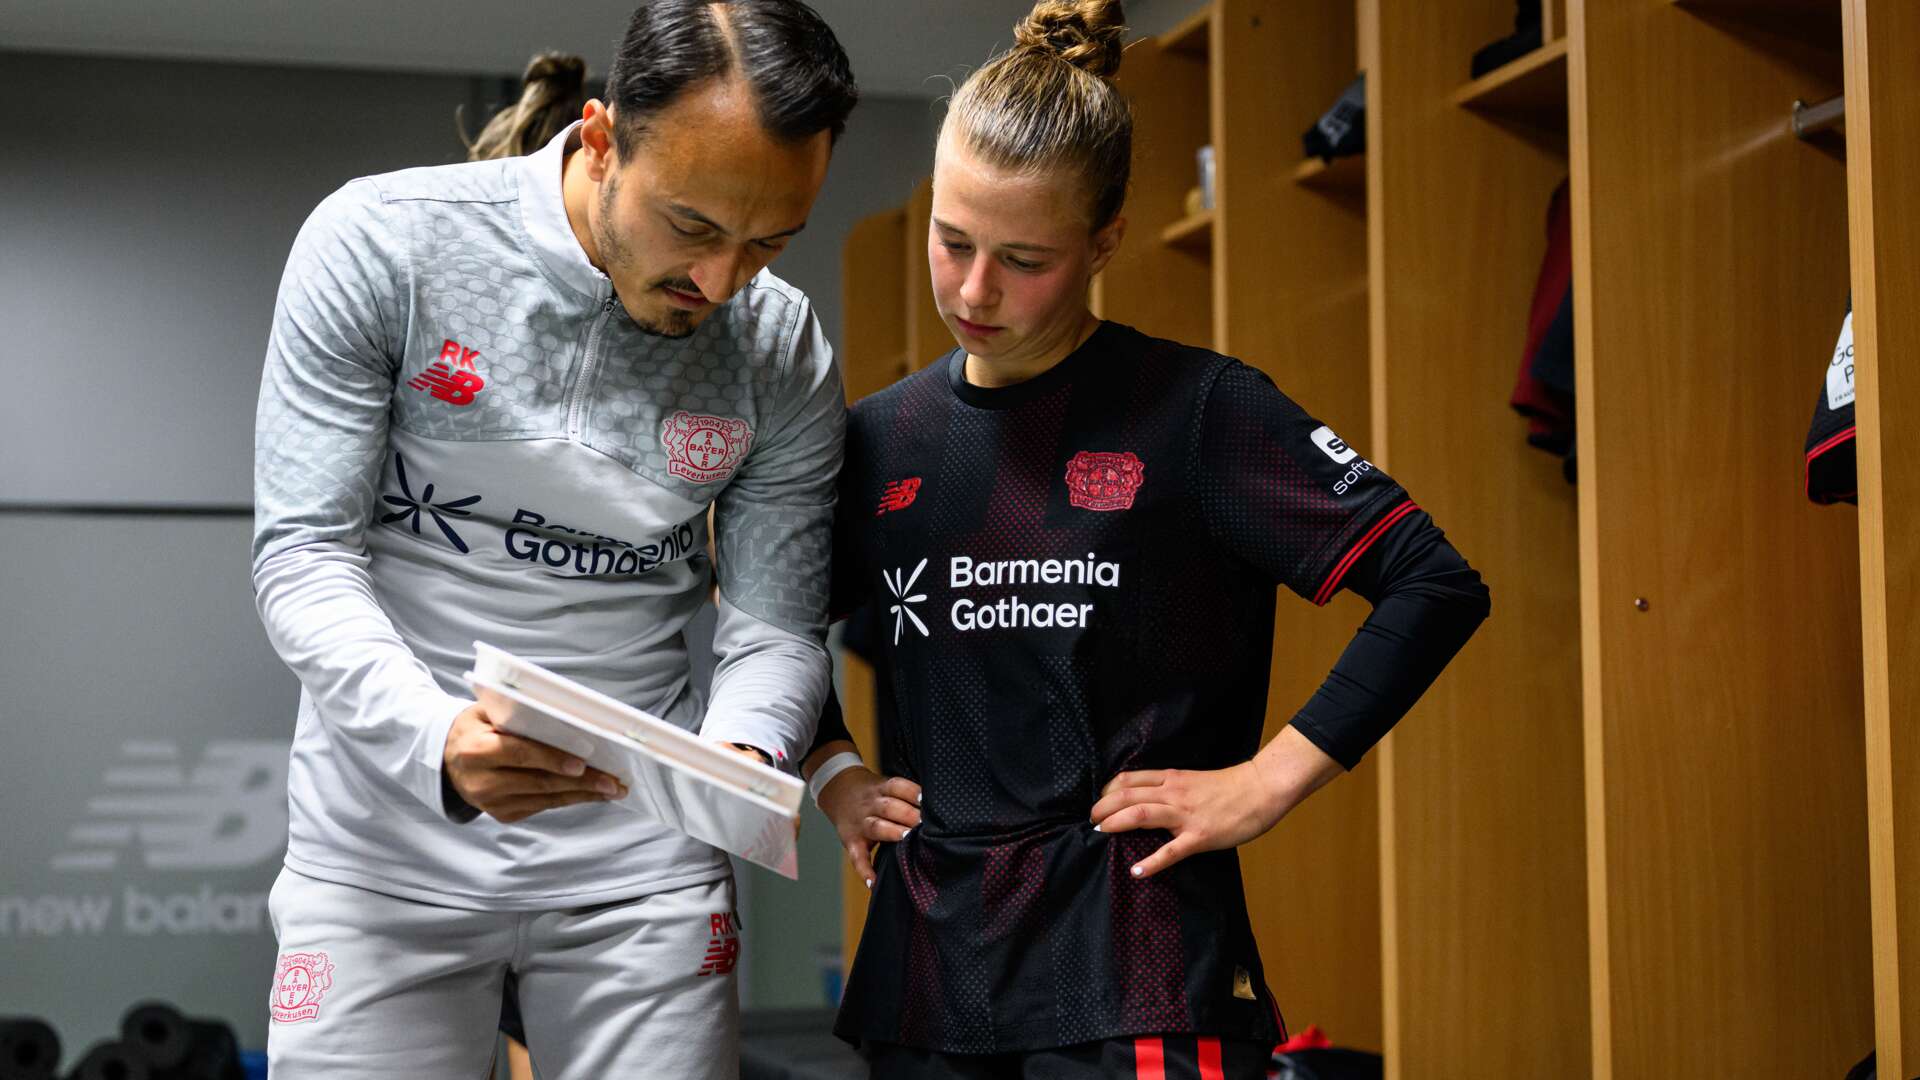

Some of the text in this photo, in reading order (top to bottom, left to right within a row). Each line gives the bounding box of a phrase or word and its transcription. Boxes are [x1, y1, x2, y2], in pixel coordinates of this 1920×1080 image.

[440, 339, 480, 371] RK
[689, 443, 725, 455] BAYER
[674, 463, 727, 480] Leverkusen
[1333, 459, 1374, 495] soft
[950, 552, 1120, 588] Barmenia
[950, 595, 1093, 631] Gothaer
[710, 912, 733, 936] RK
